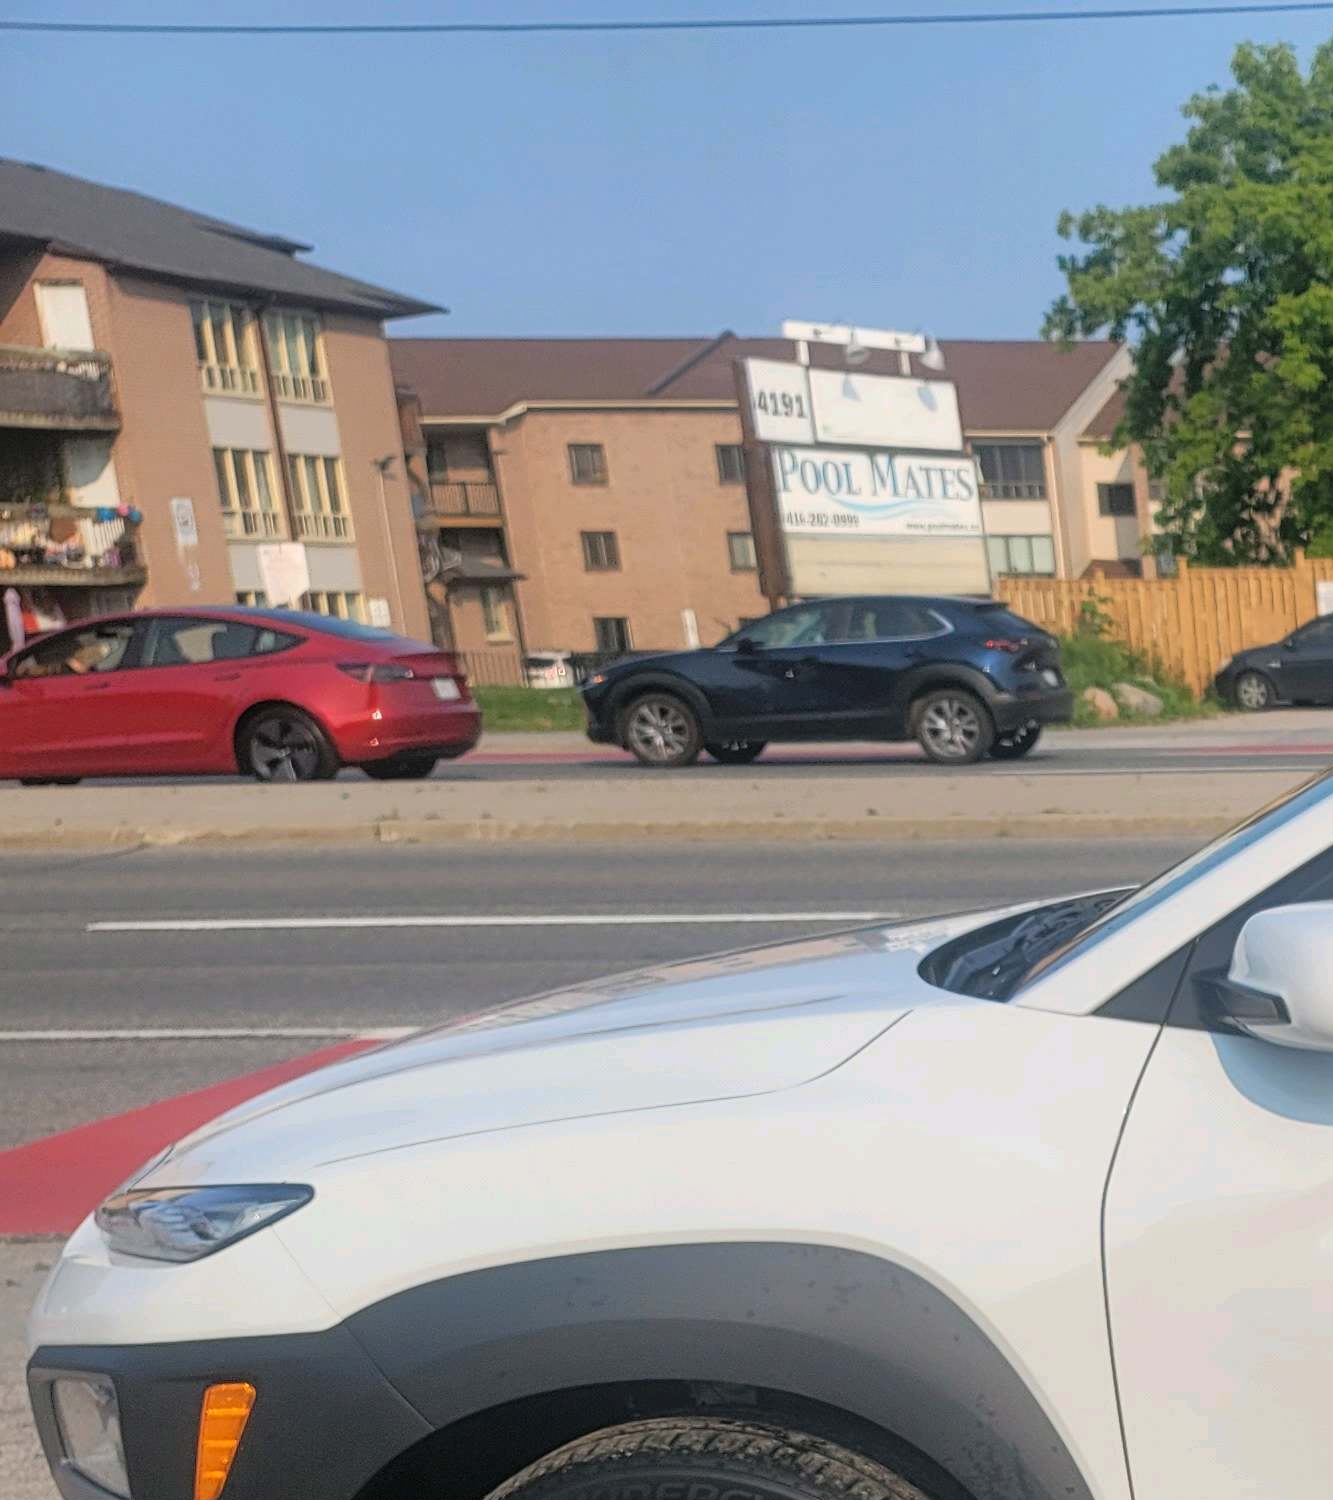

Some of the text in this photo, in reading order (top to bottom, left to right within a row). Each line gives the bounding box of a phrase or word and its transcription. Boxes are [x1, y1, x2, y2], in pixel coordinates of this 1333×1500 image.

[756, 389, 806, 419] 4191
[777, 448, 976, 501] POOL MATES
